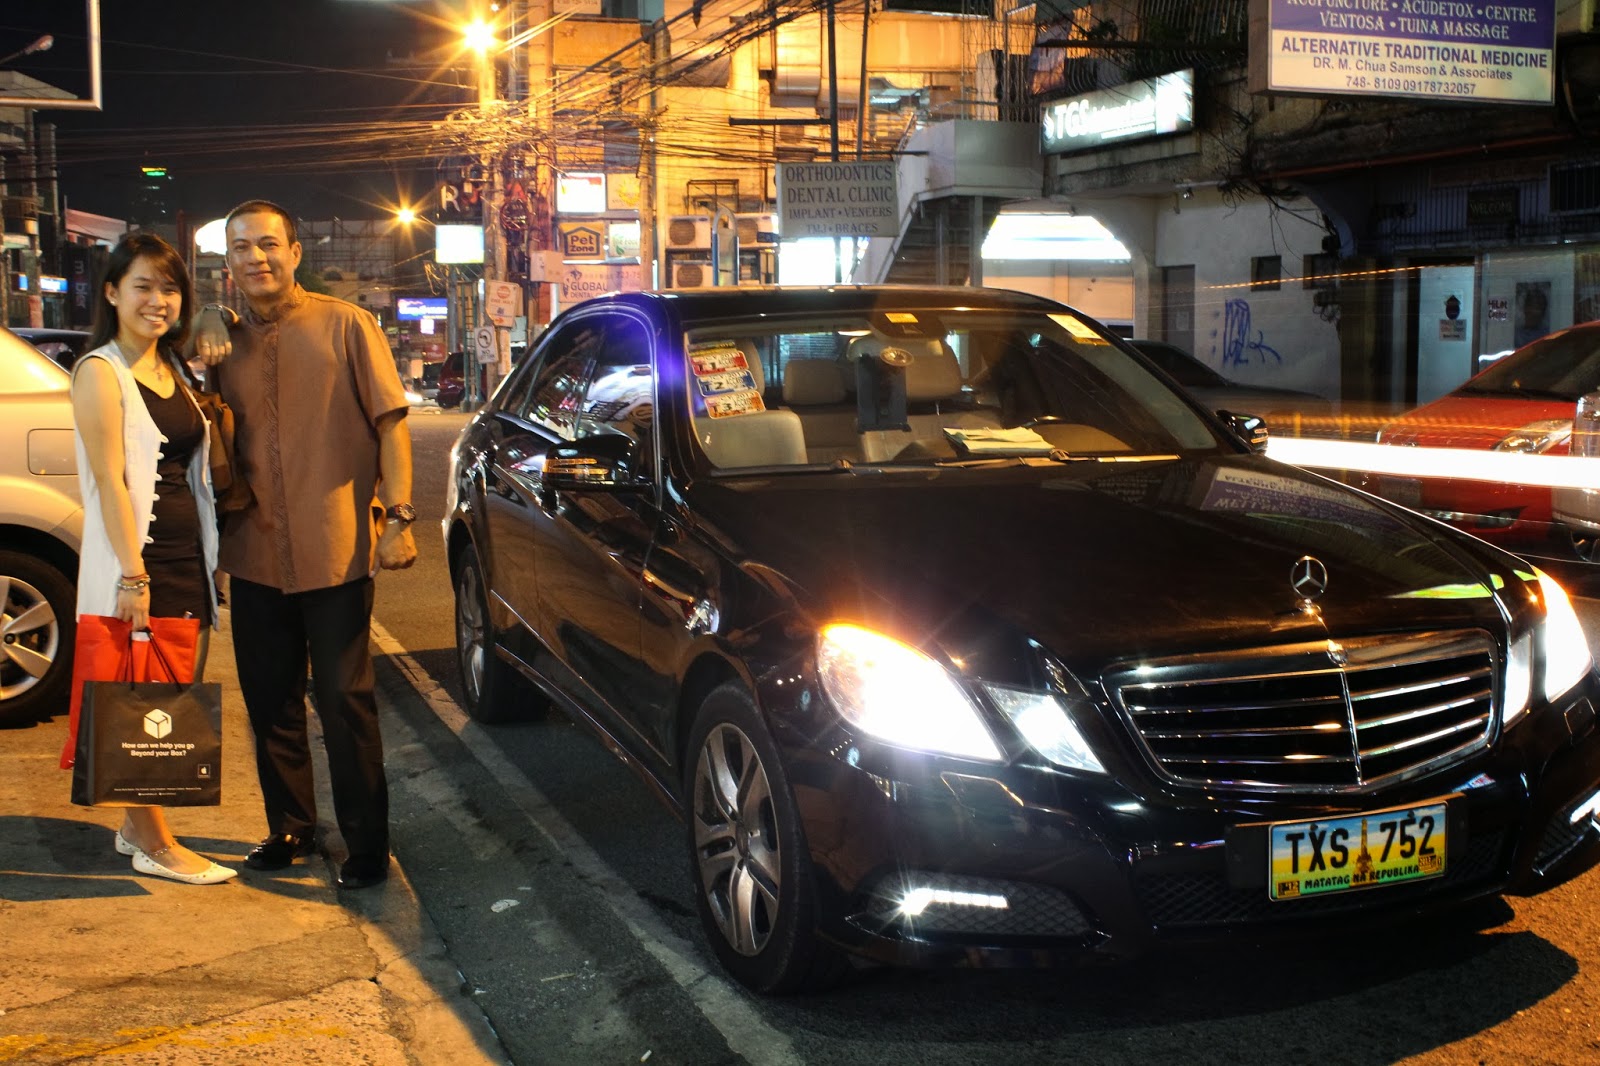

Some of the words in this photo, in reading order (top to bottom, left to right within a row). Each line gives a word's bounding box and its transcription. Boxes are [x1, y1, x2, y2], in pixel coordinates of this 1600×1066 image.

[1401, 0, 1475, 18] ACUDETOX
[1485, 5, 1536, 23] CENTRE
[1320, 11, 1385, 31] VENTOSA
[1398, 17, 1439, 35] TUINA
[1443, 20, 1510, 40] MASSAGE
[1281, 37, 1380, 57] ALTERNATIVE
[1384, 43, 1478, 64] TRADITIONAL
[1481, 49, 1548, 69] MEDICINE
[1313, 56, 1335, 69] DR.
[1338, 58, 1352, 71] M.
[1355, 59, 1386, 72] Chua
[1389, 61, 1436, 76] Samson
[1439, 64, 1448, 76] &
[1450, 65, 1513, 80] Associates
[1374, 77, 1401, 90] 8109
[1403, 80, 1477, 95] 09178732057
[1054, 98, 1090, 140] TGS
[786, 164, 893, 182] ORTHODONTICS
[788, 187, 845, 203] DENTAL
[848, 186, 893, 203] CLINIC
[789, 208, 836, 220] IMPLANT
[843, 206, 893, 218] VENEERS
[806, 223, 827, 235] TMJ
[836, 223, 879, 234] BRACES
[571, 235, 594, 245] Pet
[571, 281, 608, 292] GLOBAL
[160, 742, 173, 750] help
[1286, 827, 1349, 874] TXS
[1380, 815, 1435, 863] 752
[1304, 874, 1350, 889] MATATAG
[1353, 871, 1366, 883] NA
[1369, 865, 1420, 881] REPUBLIKA
